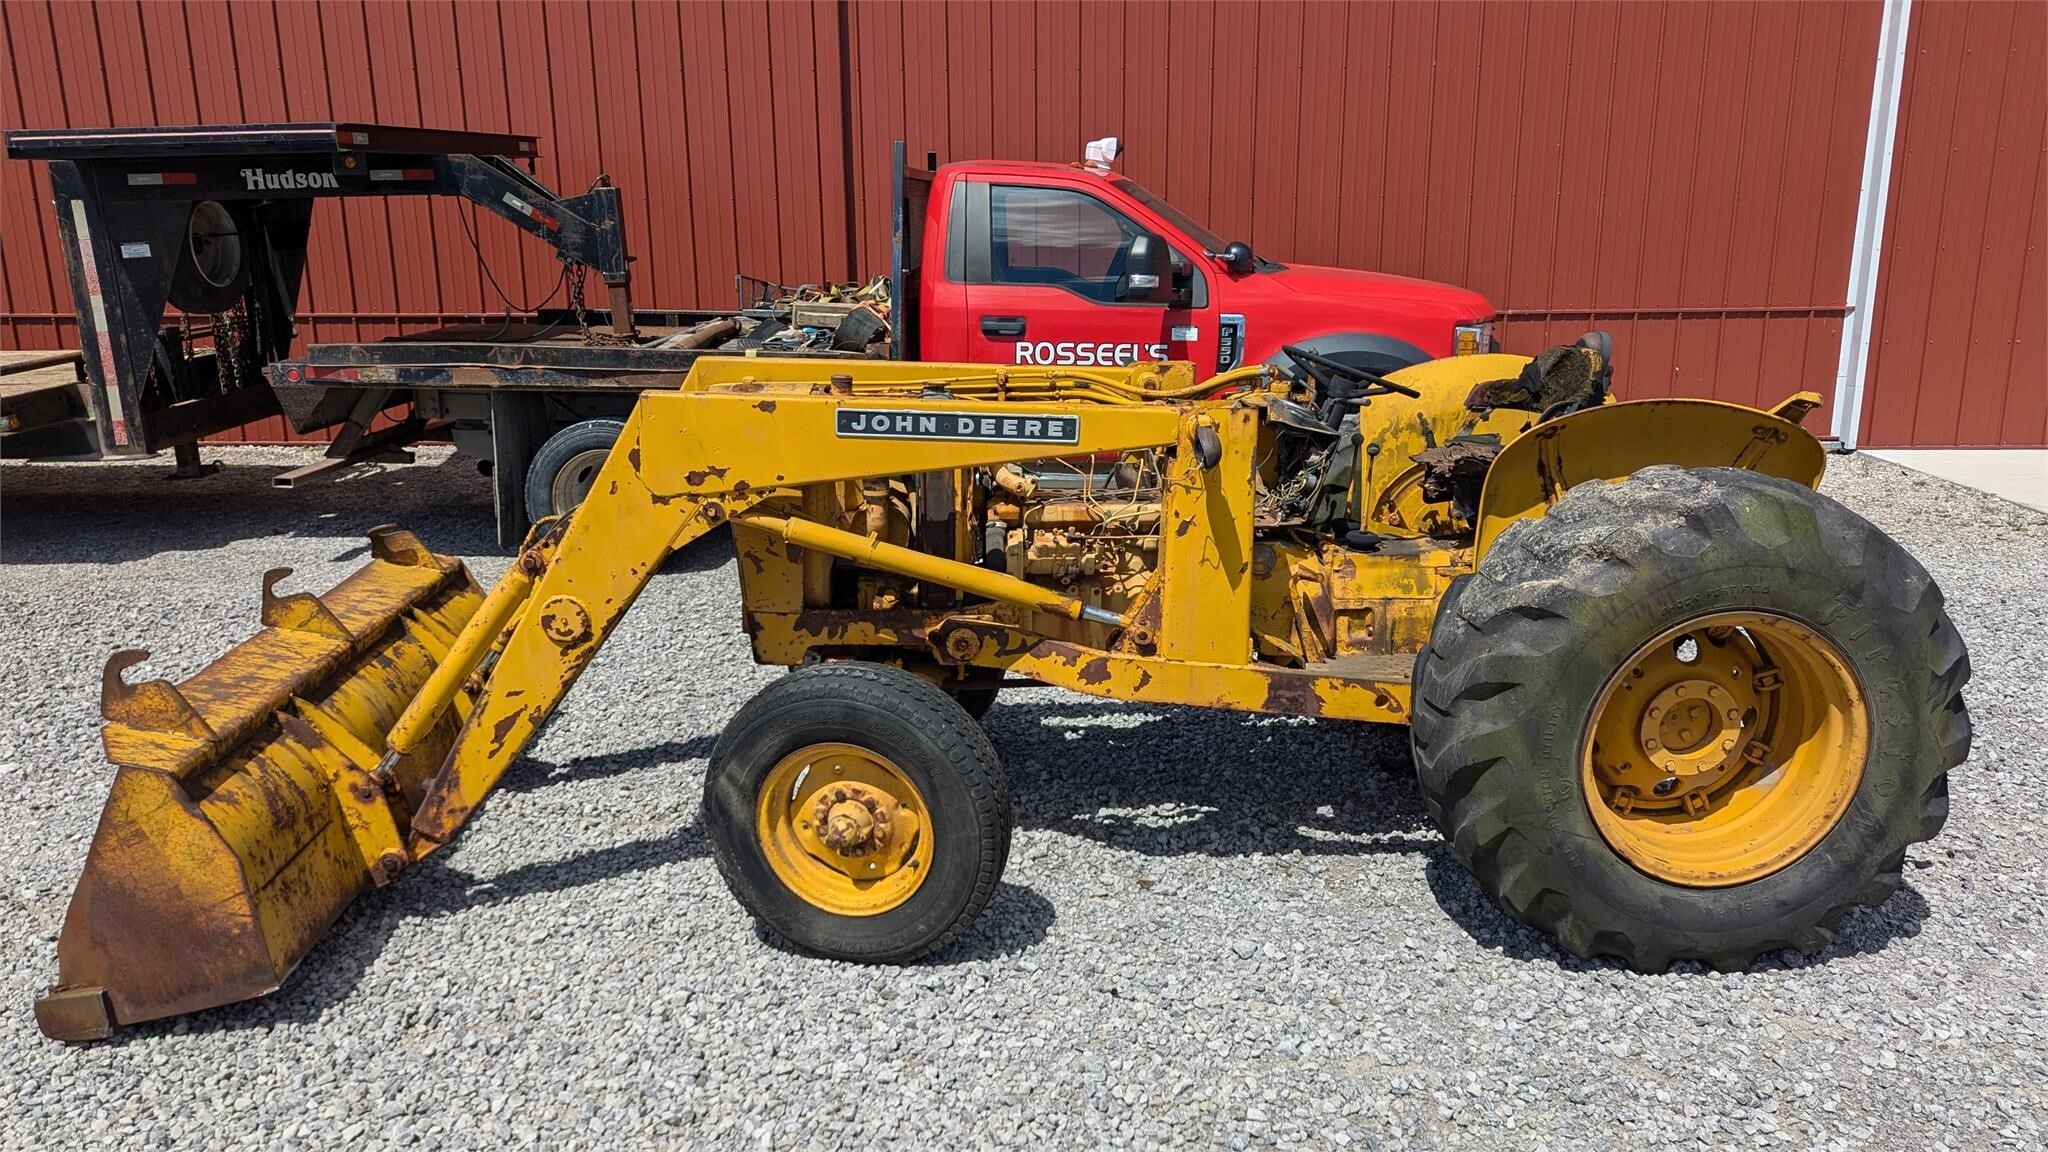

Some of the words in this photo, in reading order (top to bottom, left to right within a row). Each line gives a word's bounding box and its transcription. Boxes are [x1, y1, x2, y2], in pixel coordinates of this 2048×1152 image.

[240, 168, 339, 190] Hudson
[851, 414, 936, 432] JOHN
[958, 418, 1064, 437] DEERE
